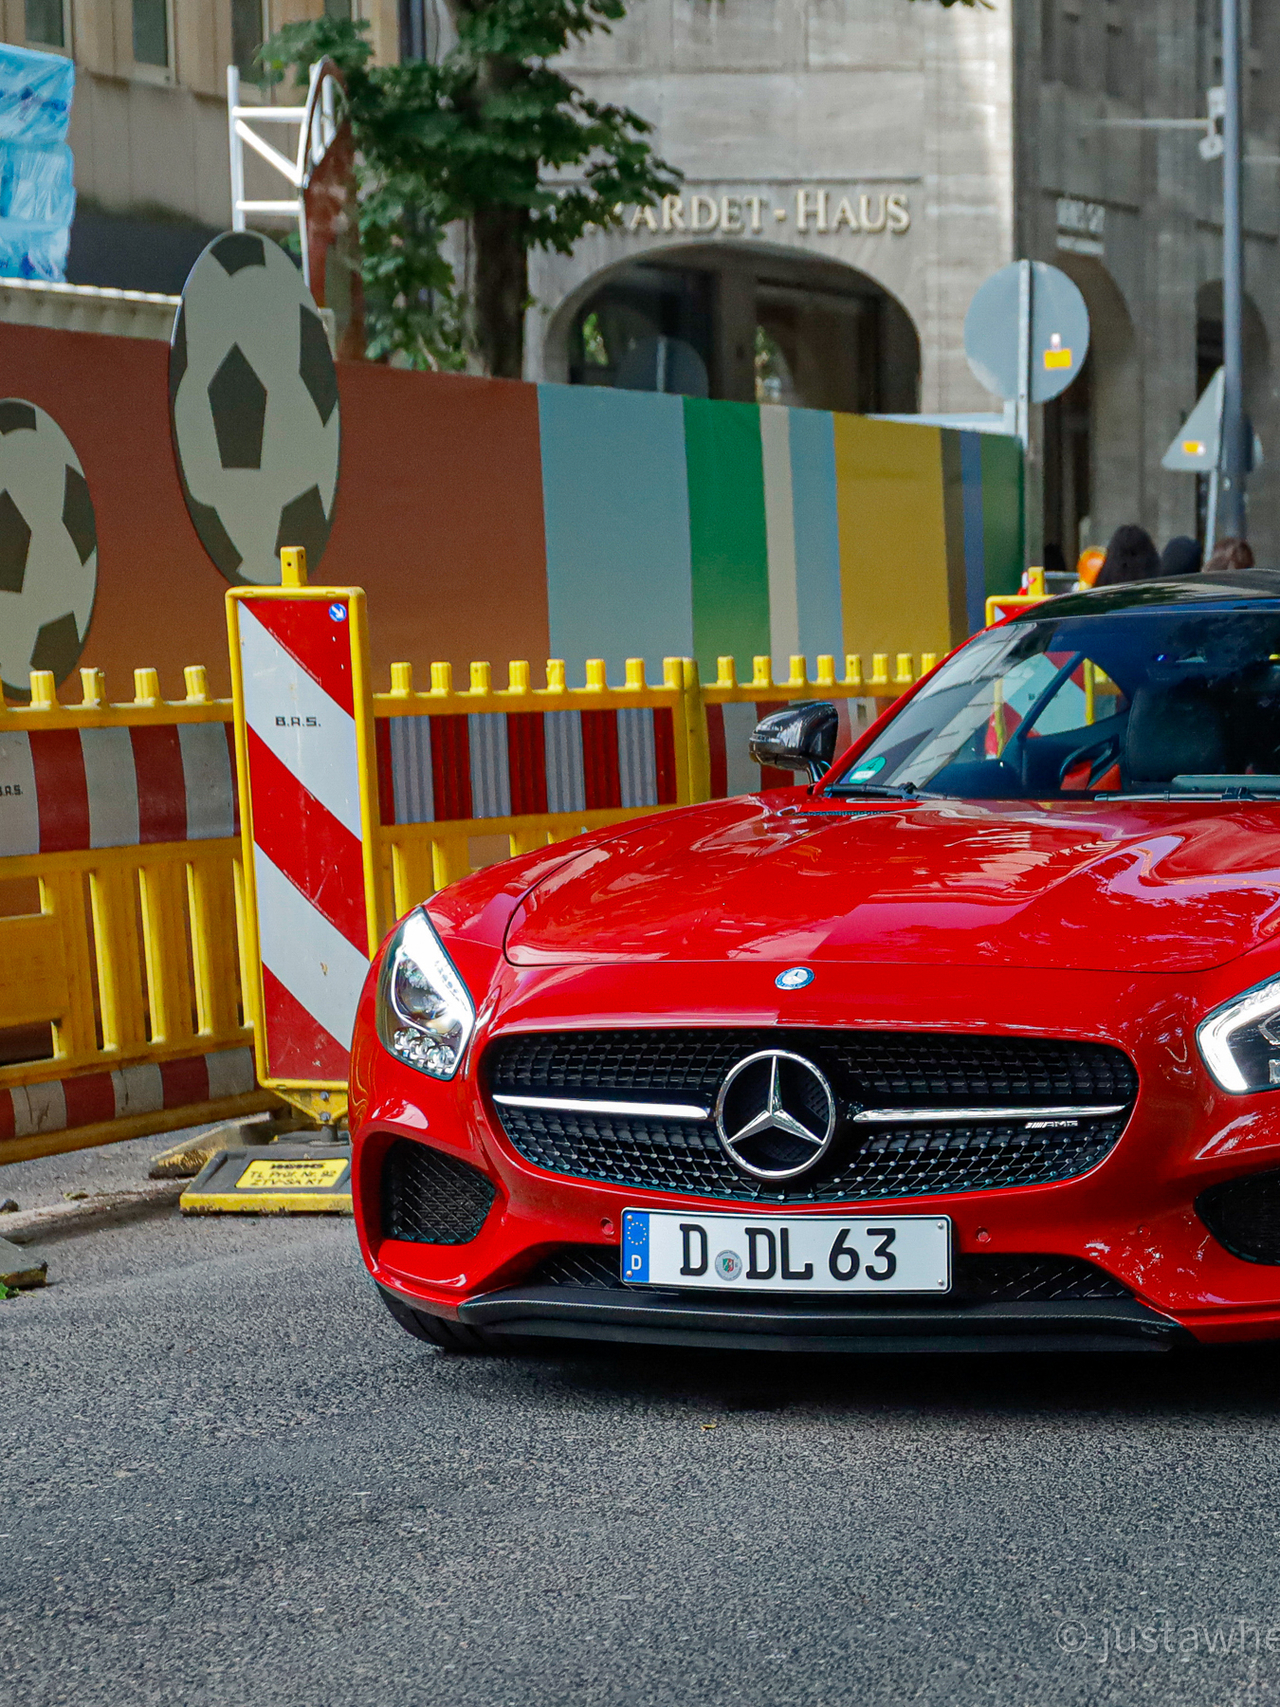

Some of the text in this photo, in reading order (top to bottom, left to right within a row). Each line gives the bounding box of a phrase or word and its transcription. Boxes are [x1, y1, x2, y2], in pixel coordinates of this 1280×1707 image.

[275, 716, 322, 727] B.A.S.
[679, 1223, 709, 1276] D
[744, 1227, 814, 1280] DL
[828, 1227, 897, 1282] 63
[630, 1254, 643, 1271] D
